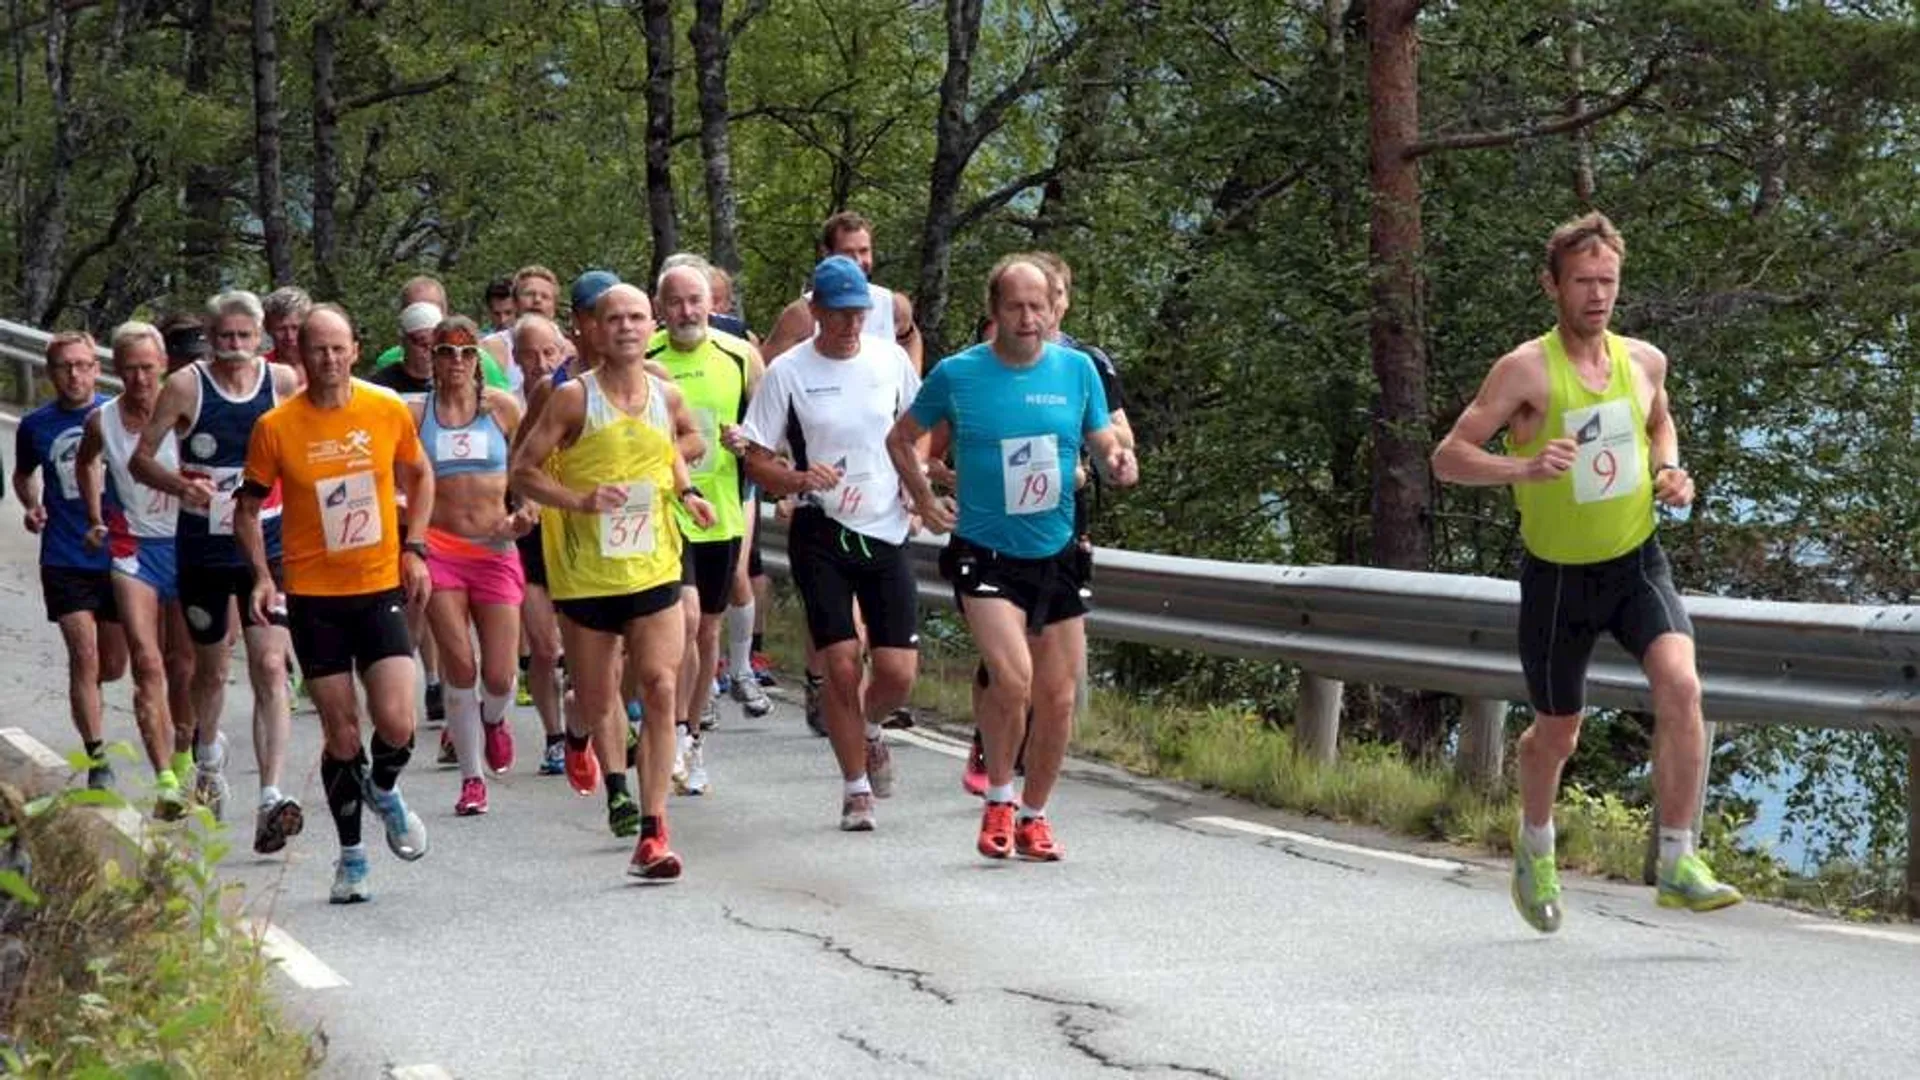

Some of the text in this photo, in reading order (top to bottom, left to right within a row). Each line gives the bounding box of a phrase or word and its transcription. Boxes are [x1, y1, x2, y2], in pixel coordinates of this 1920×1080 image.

[452, 431, 471, 458] 3
[1018, 472, 1048, 506] 19
[1593, 449, 1616, 496] 9
[838, 485, 862, 514] 14
[340, 509, 370, 544] 12
[608, 513, 649, 548] 37
